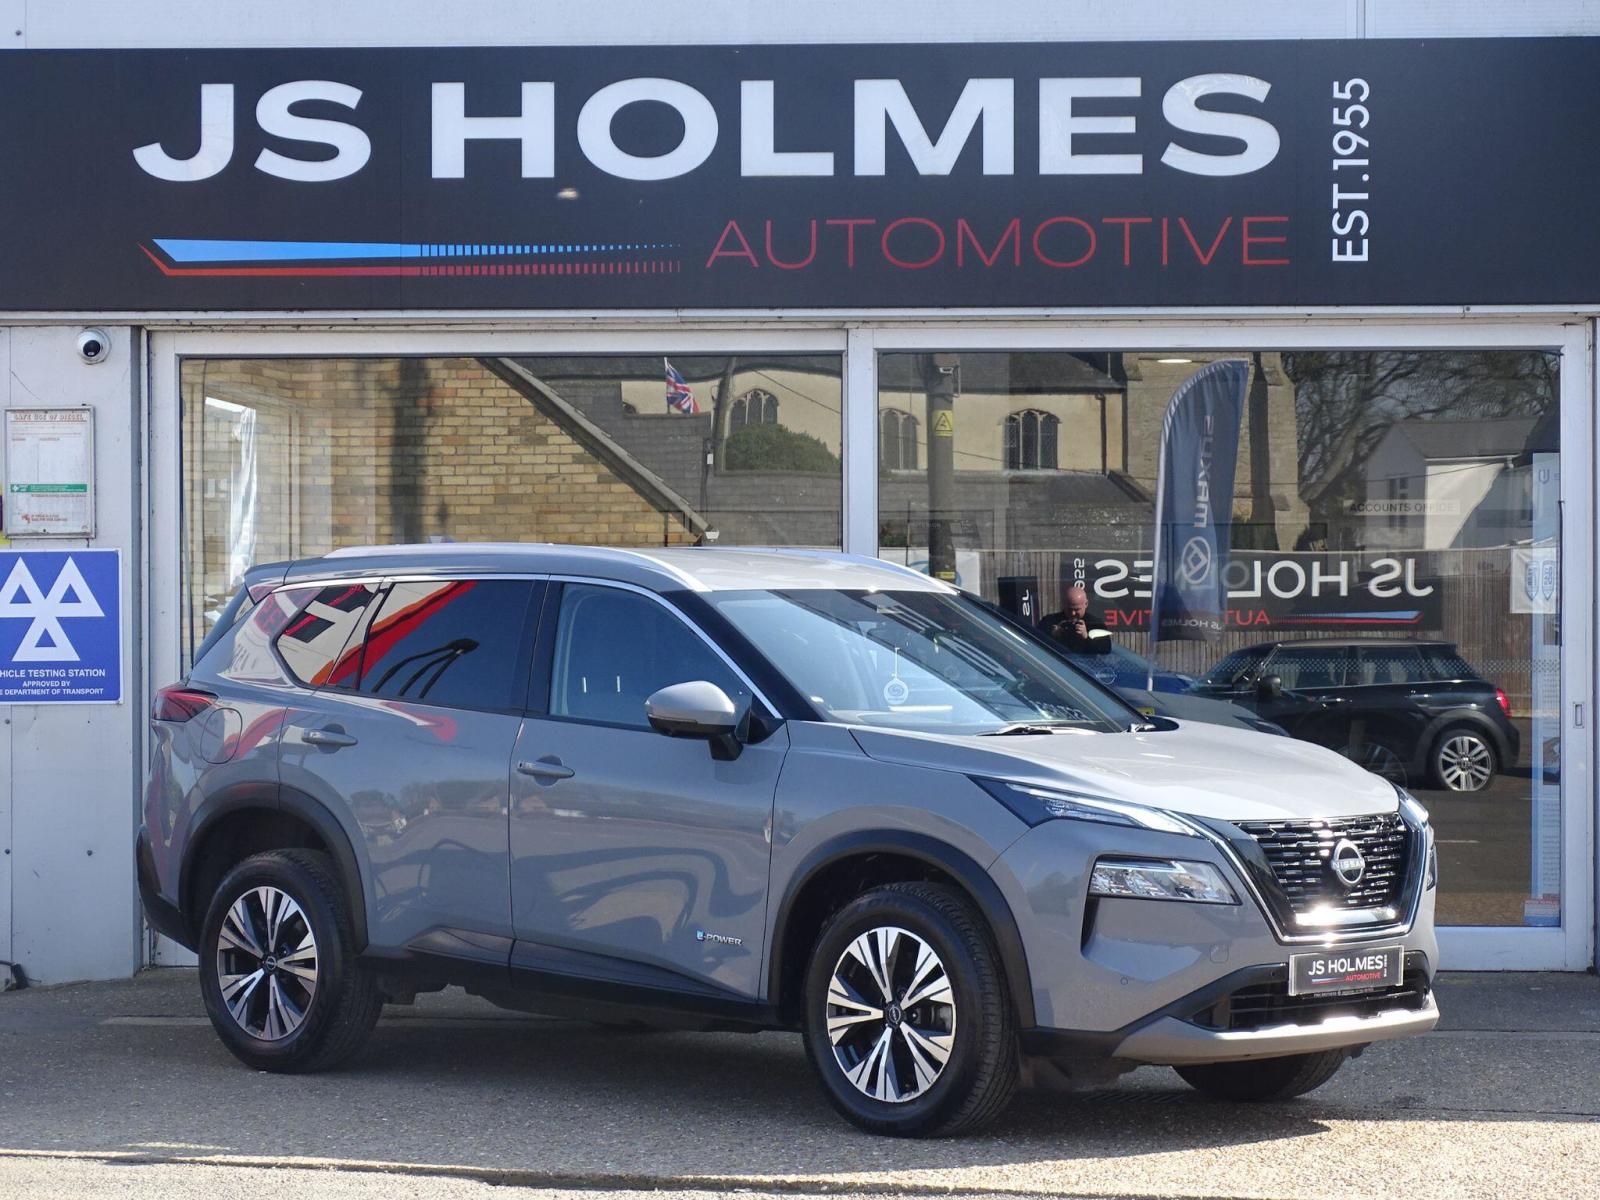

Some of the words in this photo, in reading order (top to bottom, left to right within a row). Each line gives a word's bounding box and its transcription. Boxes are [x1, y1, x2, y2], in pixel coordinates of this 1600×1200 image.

[133, 81, 371, 183] JS
[431, 74, 1281, 181] HOLMES
[1332, 77, 1370, 262] EST.1955
[706, 215, 1291, 269] AUTOMOTIVE
[1350, 503, 1411, 512] ACCOUNTS
[0, 669, 26, 678] HICLE
[28, 669, 66, 678] TESTING
[68, 668, 106, 677] STATION
[22, 680, 60, 688] APPROVED
[61, 680, 71, 688] BY
[4, 688, 50, 696] DEPARTMENT
[62, 687, 104, 695] TRANSPORT
[1308, 961, 1325, 976] JS
[1328, 955, 1383, 973] HOLMES
[1345, 972, 1382, 981] AUTOMOTIVE
